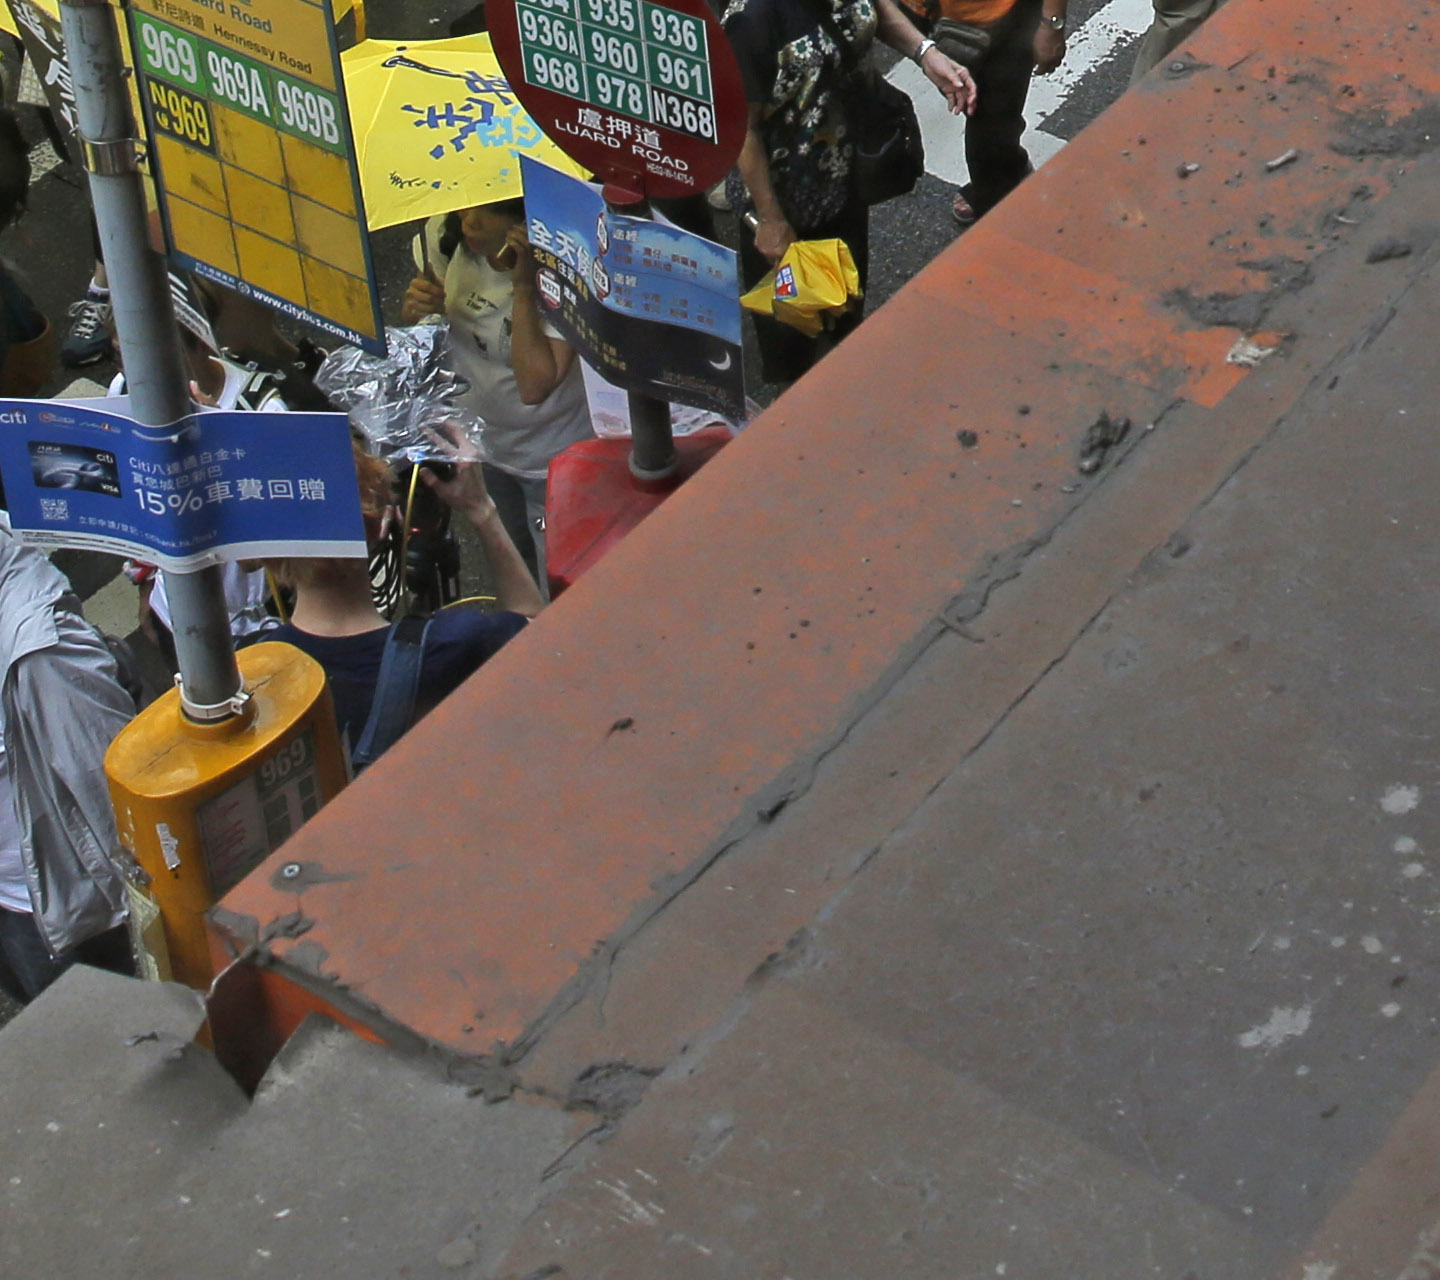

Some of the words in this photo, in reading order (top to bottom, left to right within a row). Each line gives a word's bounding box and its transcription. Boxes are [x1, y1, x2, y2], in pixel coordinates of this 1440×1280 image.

[230, 2, 272, 34] Road
[650, 9, 698, 52] 936
[213, 23, 275, 62] Hennessy
[278, 49, 312, 75] Road
[521, 10, 579, 57] 936A
[590, 31, 639, 75] 960
[657, 52, 705, 96] 961
[142, 23, 197, 84] 969
[207, 50, 270, 118] 969A
[278, 79, 339, 144] 969B
[532, 53, 579, 94] 968
[596, 76, 644, 117] 978
[653, 89, 714, 139] N368
[150, 80, 210, 147] N969
[578, 107, 662, 151] 盧押道
[555, 119, 620, 150] LUARD
[632, 145, 688, 171] ROAD
[253, 288, 362, 345] www.citybus.com.hk
[0, 410, 27, 425] citi
[135, 488, 203, 515] 15%
[206, 478, 326, 505] 車費回贈
[261, 738, 306, 788] 969
